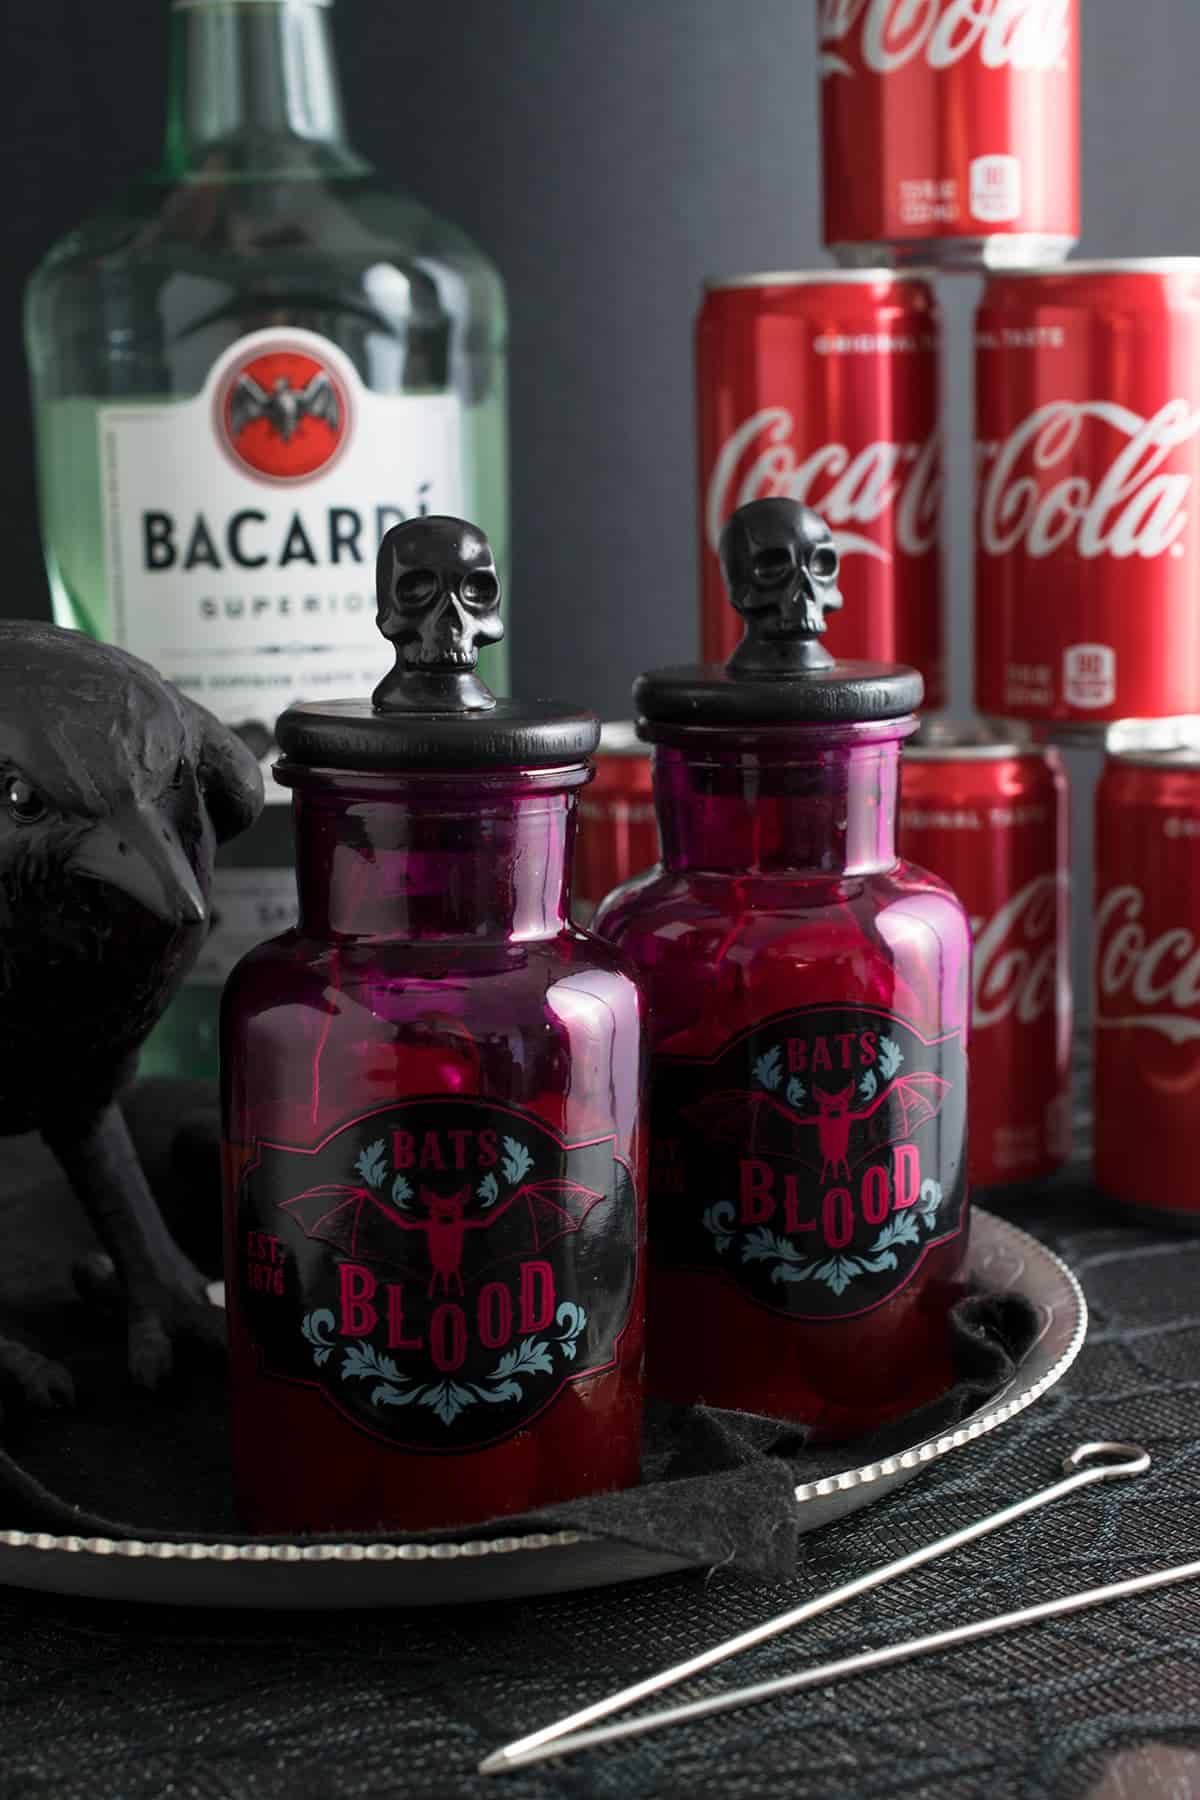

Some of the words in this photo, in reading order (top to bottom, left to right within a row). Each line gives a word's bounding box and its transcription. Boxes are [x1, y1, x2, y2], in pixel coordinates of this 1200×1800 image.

[201, 591, 377, 620] SUPERIO
[785, 1031, 878, 1073] BATS
[393, 1130, 498, 1170] BATS
[738, 1143, 921, 1249] BLOOD
[338, 1260, 556, 1372] BLOOD
